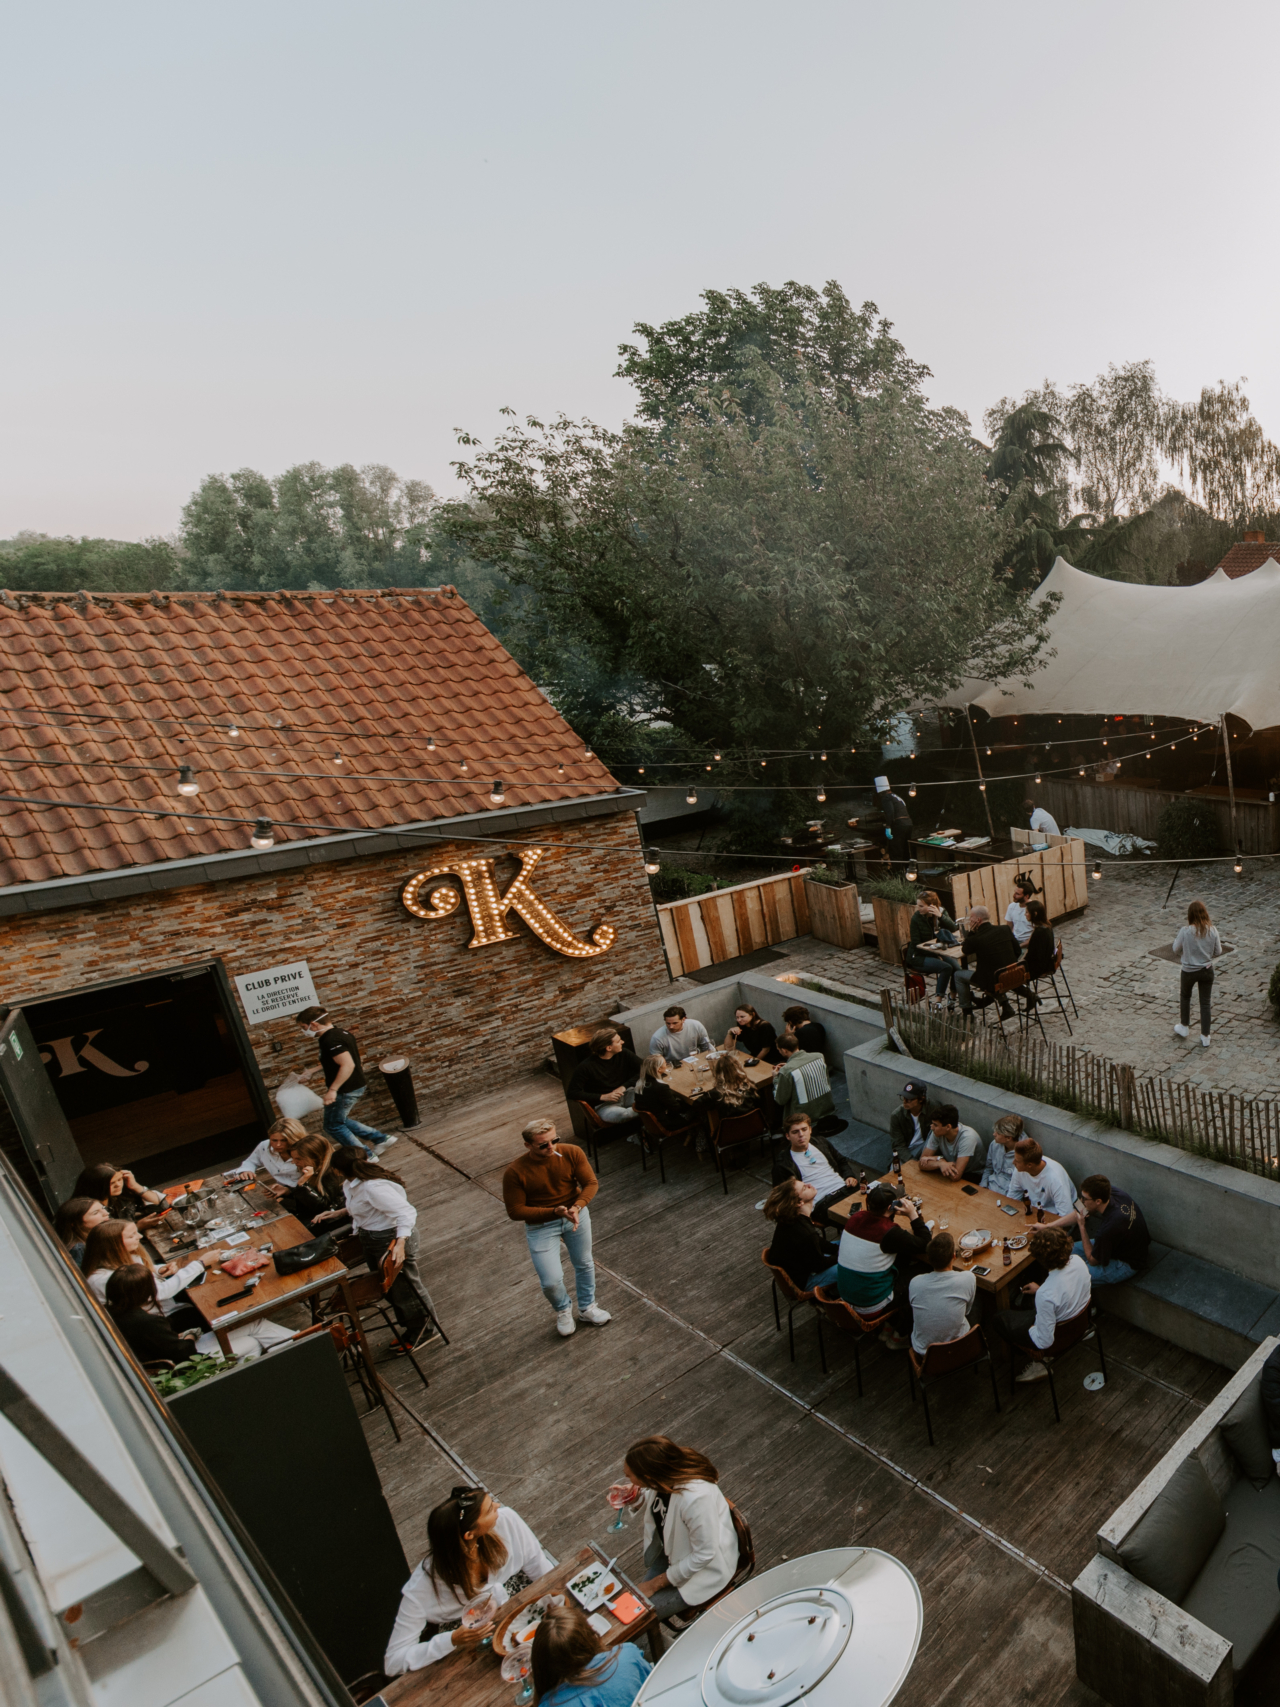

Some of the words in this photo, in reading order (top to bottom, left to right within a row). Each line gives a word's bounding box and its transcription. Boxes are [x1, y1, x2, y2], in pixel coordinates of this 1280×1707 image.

[401, 848, 618, 958] K
[245, 979, 272, 991] CLUB
[274, 971, 304, 984] PRIVE
[267, 986, 300, 998] DIRECTION
[271, 992, 299, 1003] RESERVE
[261, 1003, 280, 1013] DROIT
[282, 995, 311, 1007] D'ENTREE
[37, 1028, 149, 1077] K
